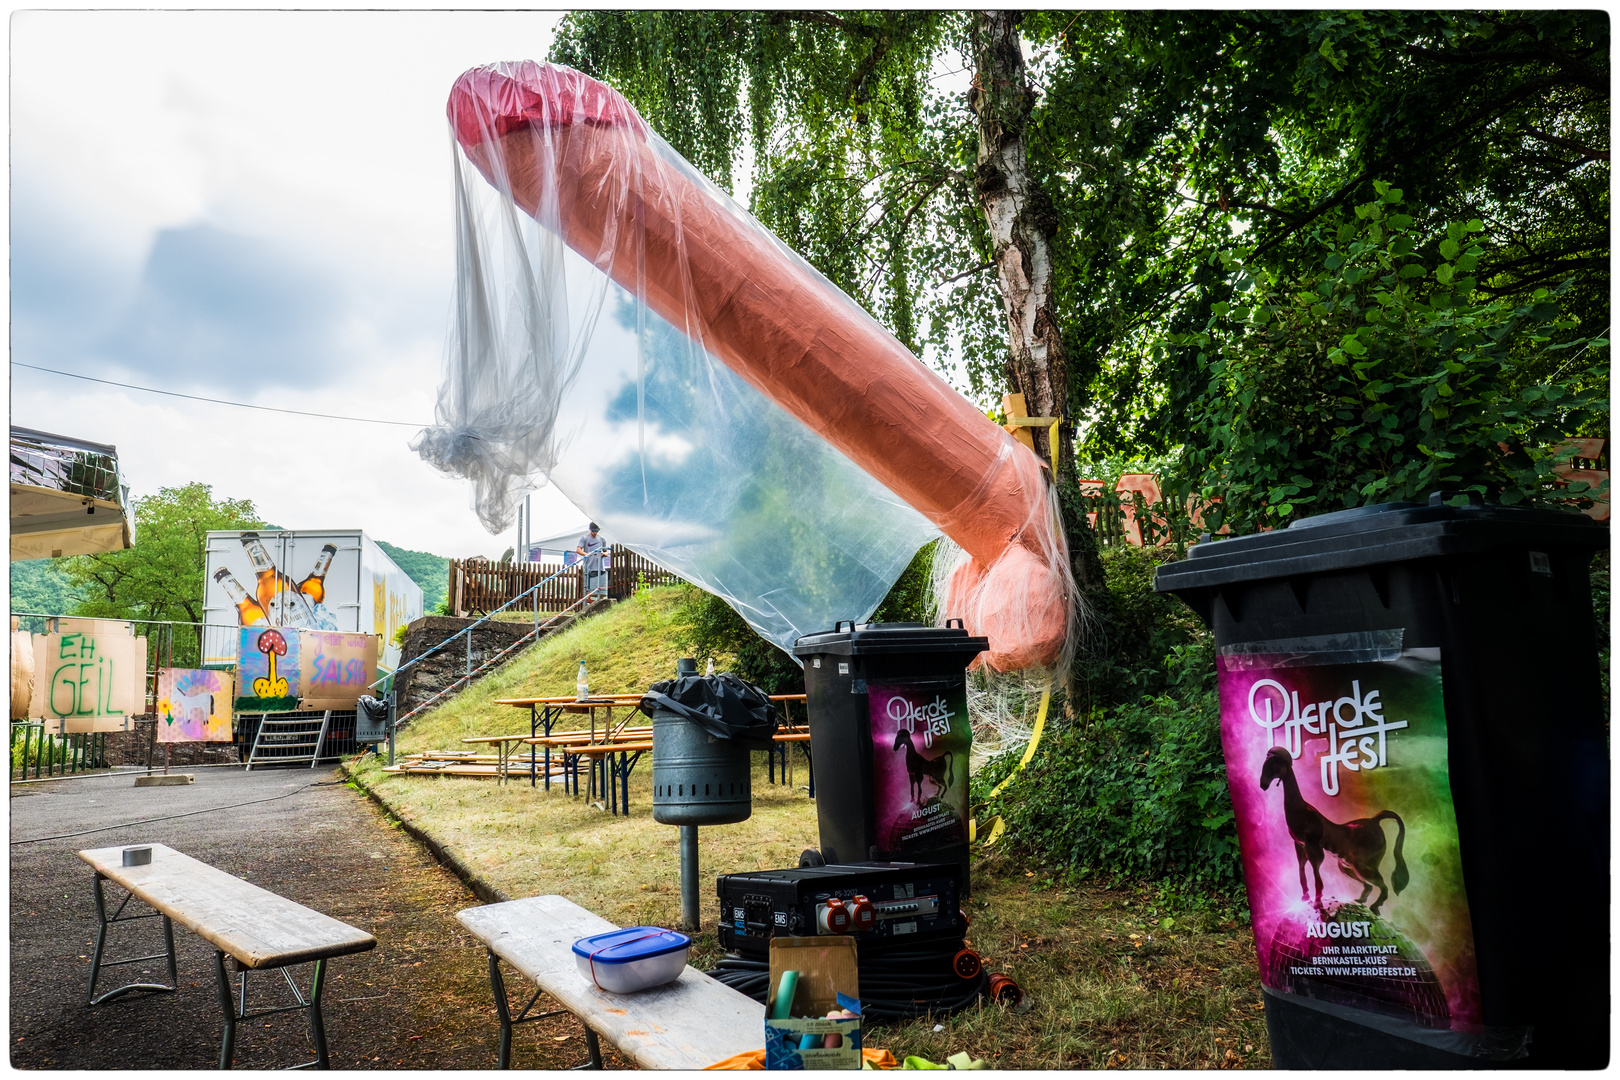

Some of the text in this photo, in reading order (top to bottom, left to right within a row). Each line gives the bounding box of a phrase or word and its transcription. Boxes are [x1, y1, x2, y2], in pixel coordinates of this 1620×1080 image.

[60, 633, 96, 660] EH
[310, 654, 367, 687] SALSIG
[886, 694, 948, 735] Pferde
[1248, 678, 1382, 760] Pferde
[911, 803, 941, 820] AUGUST
[774, 914, 786, 924] EMS
[1306, 921, 1370, 938] AUGUST
[1322, 945, 1398, 955] UHR MARKTPLATZ
[1312, 956, 1388, 965] BERNKASTEL-KUES
[1290, 966, 1416, 976] TICKETS: WWW.PFERDEFEST.DE
